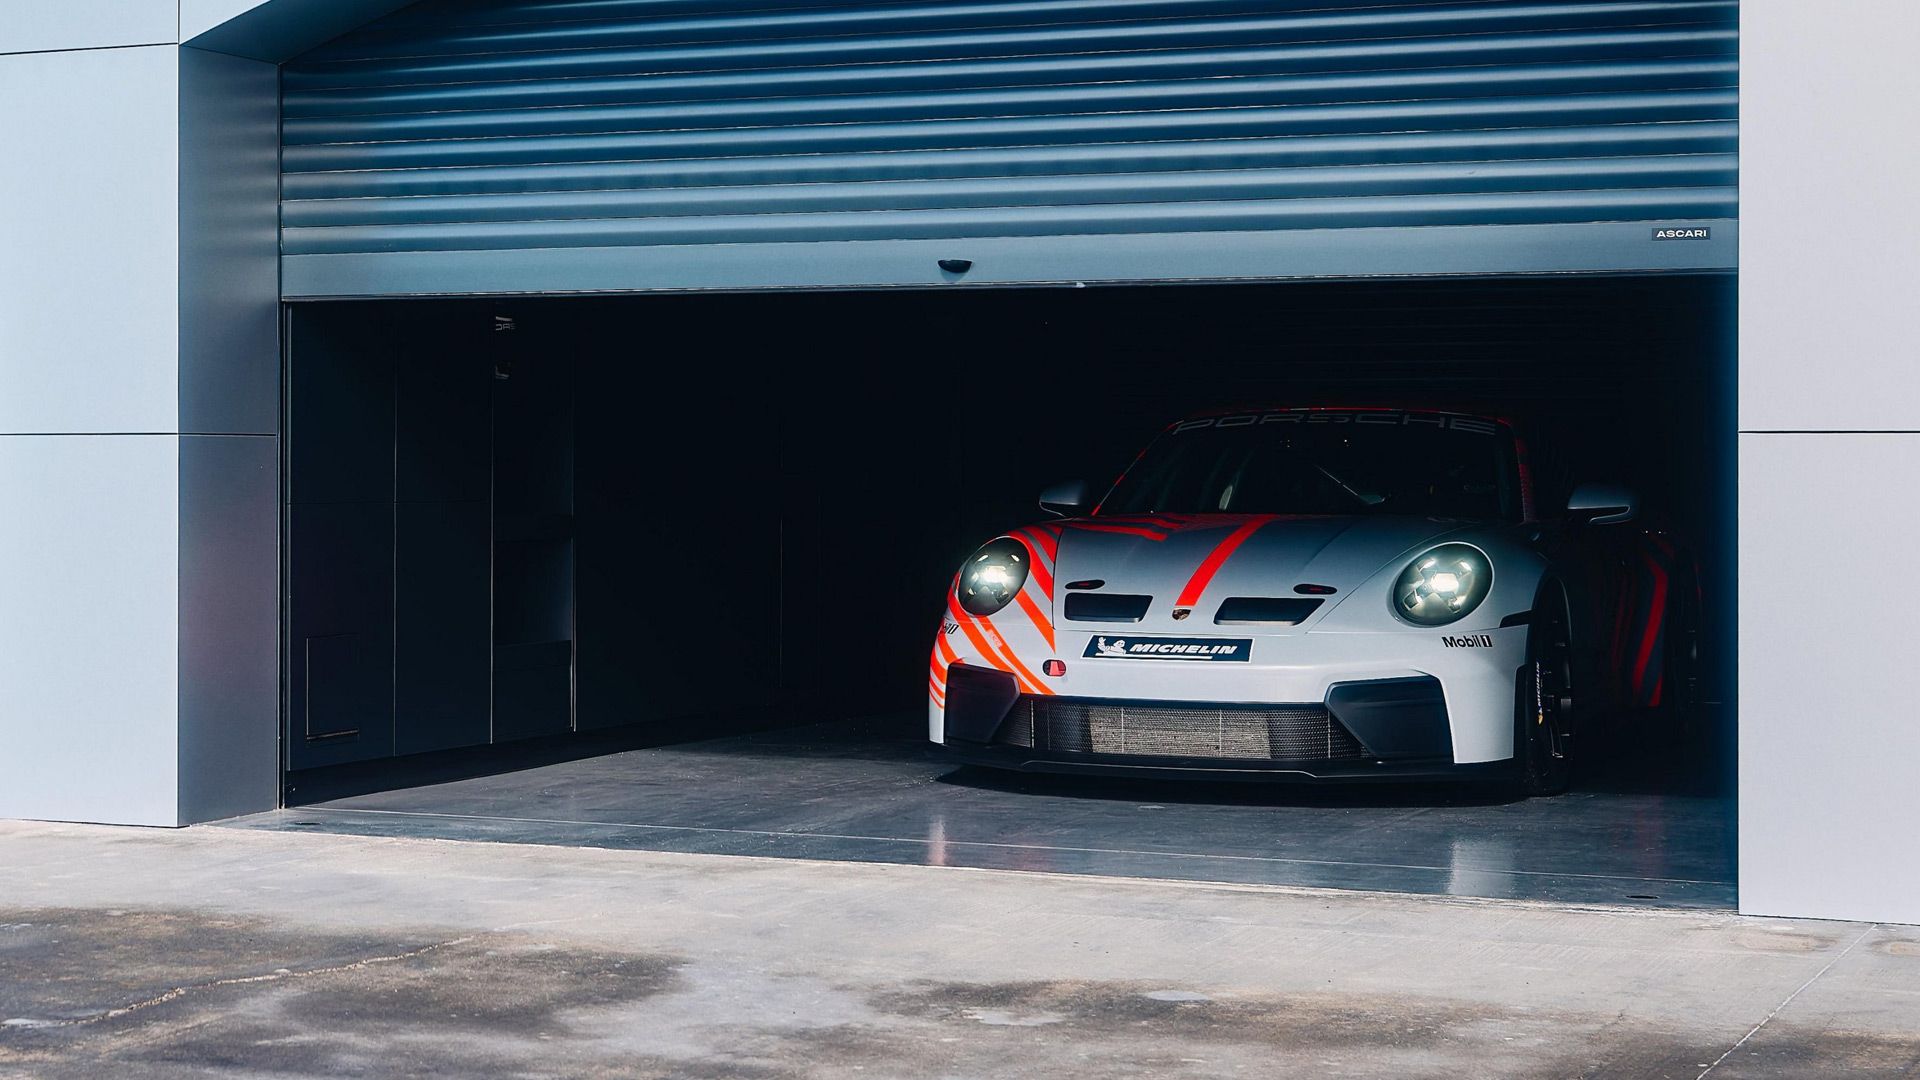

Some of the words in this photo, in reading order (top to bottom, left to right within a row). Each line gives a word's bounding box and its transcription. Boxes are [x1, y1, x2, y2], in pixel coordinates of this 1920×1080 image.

[1656, 229, 1707, 239] ASCARI
[1171, 412, 1497, 437] PORSCHE
[1129, 643, 1238, 655] MICHELIN
